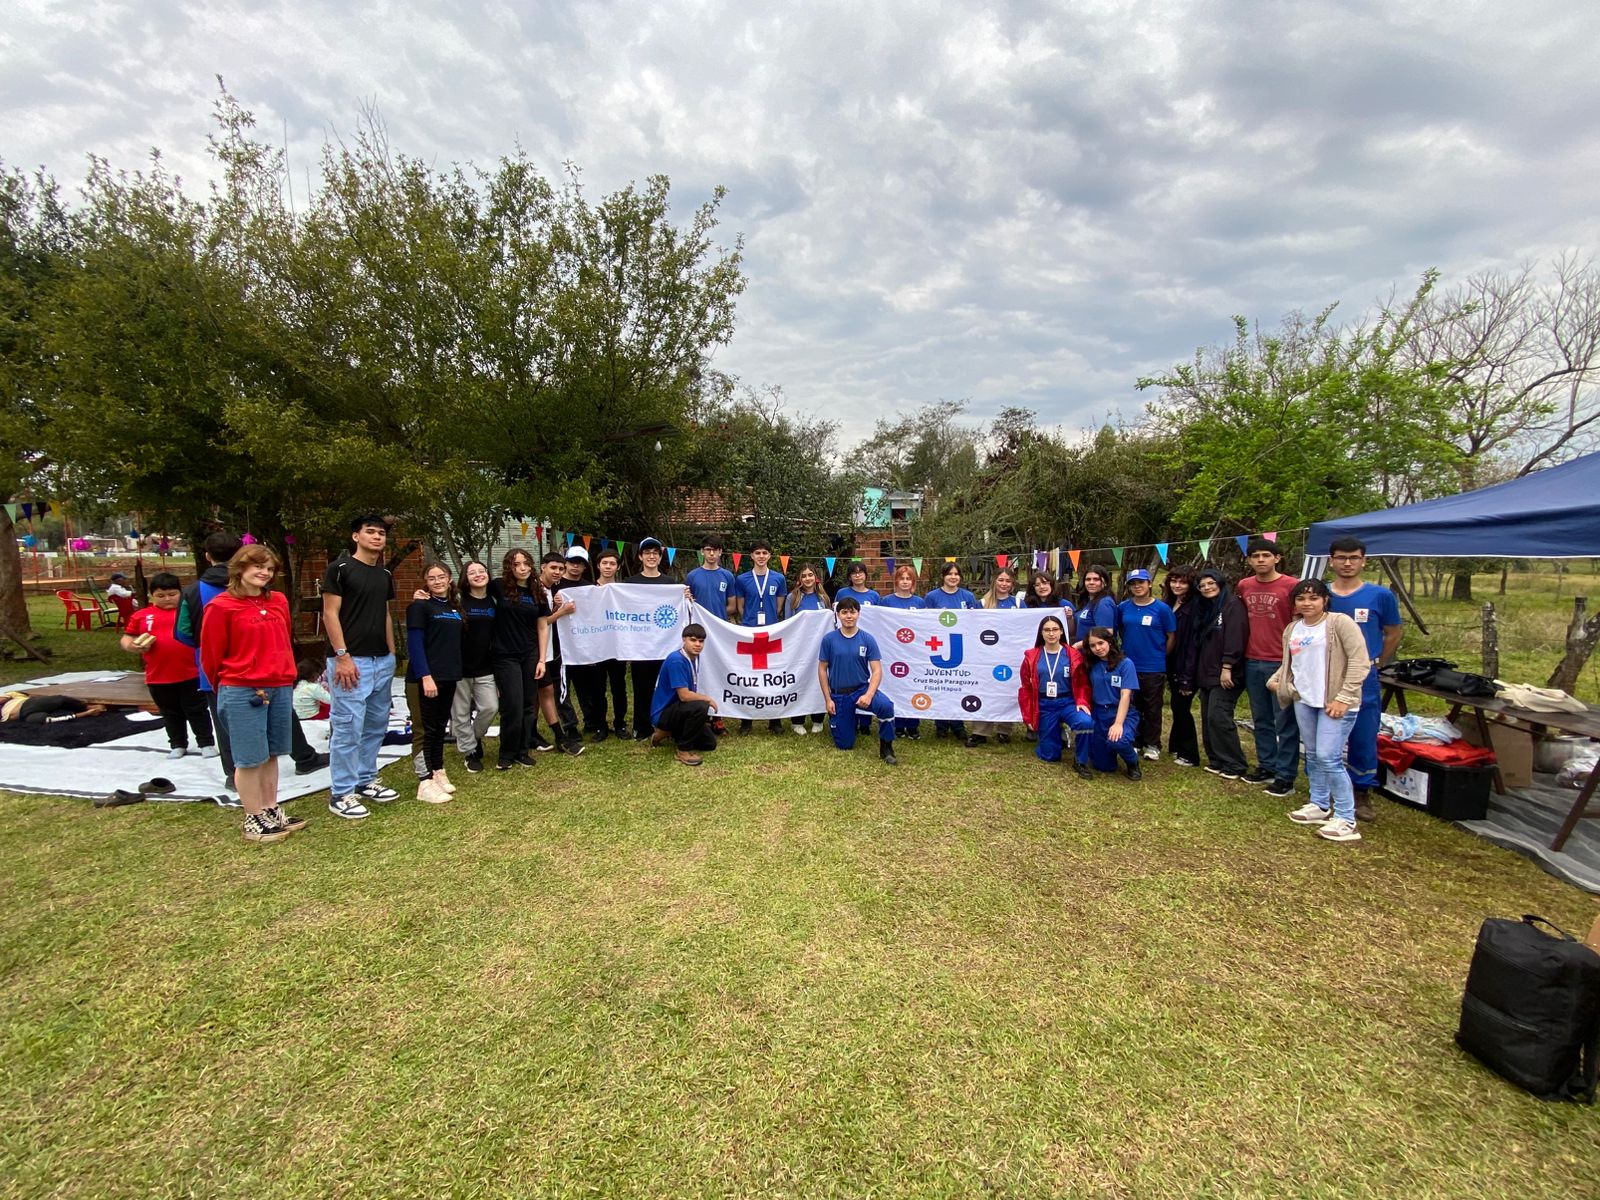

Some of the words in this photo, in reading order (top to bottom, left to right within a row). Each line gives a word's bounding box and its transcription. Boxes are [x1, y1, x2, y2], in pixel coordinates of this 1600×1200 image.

[605, 609, 651, 622] Interact
[571, 625, 590, 635] Club
[630, 624, 652, 633] Norte
[929, 633, 963, 669] J
[924, 668, 972, 677] JUVENTUD
[726, 672, 760, 687] Cruz
[763, 671, 796, 689] Roja
[944, 678, 979, 686] Paraguaya
[722, 689, 798, 710] Paraguaya
